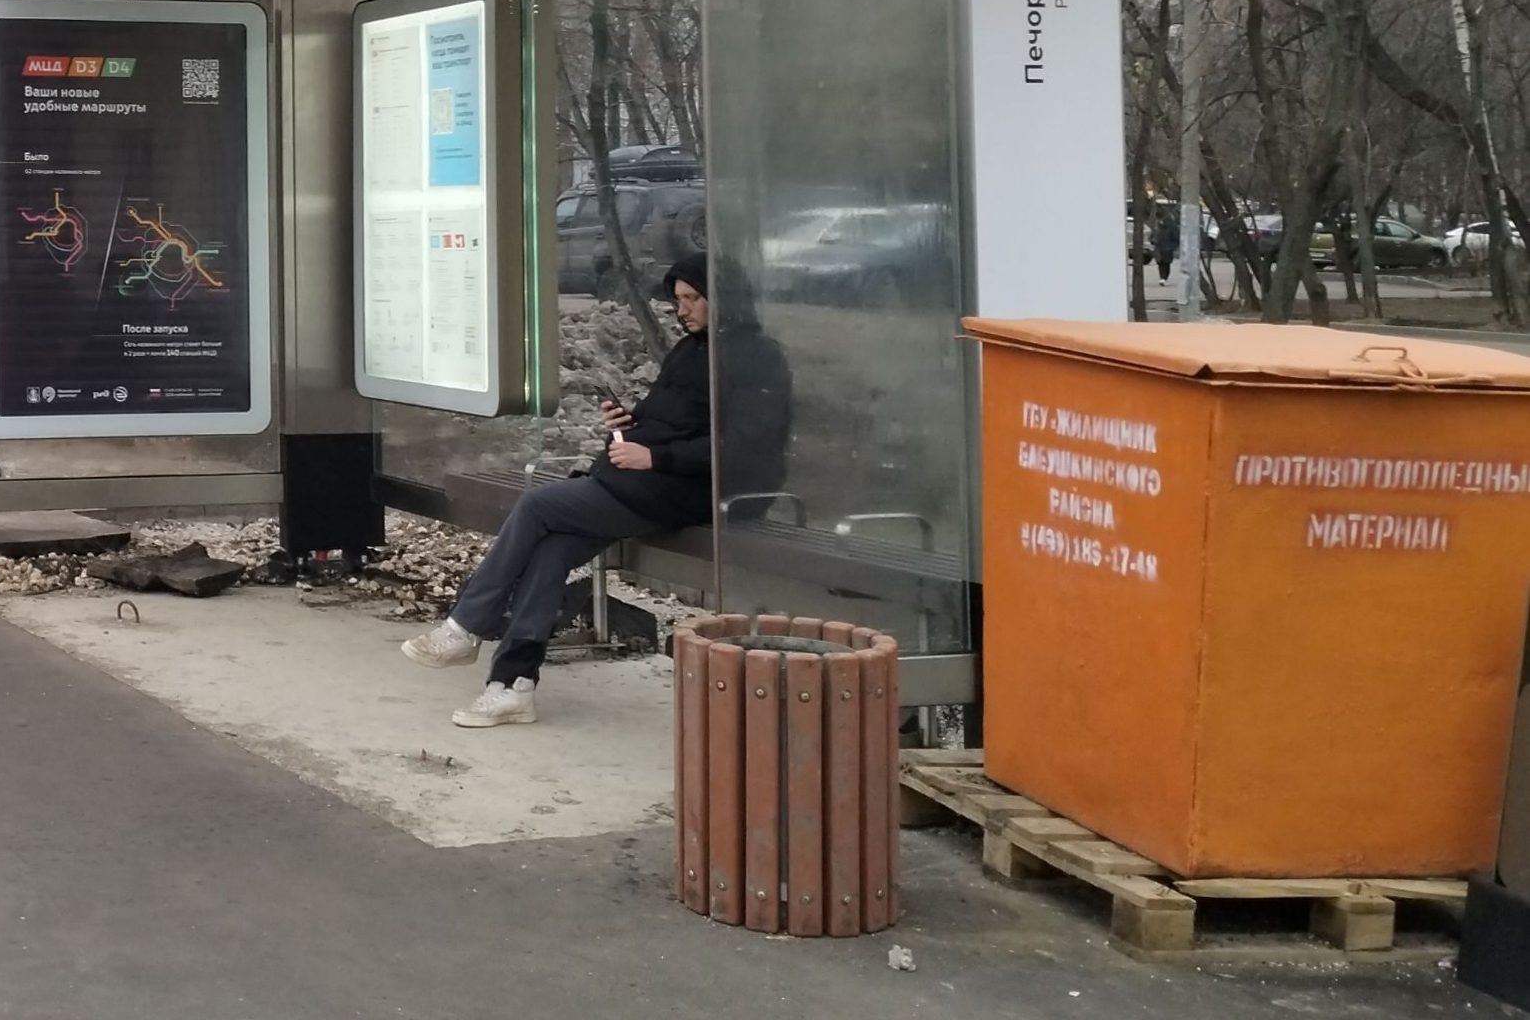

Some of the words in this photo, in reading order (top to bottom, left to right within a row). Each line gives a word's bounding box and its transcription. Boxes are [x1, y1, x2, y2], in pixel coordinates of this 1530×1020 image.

[28, 60, 63, 72] МЦД
[75, 62, 97, 74] D3
[108, 61, 130, 74] D4
[24, 85, 58, 98] Ваши
[60, 88, 101, 99] новые
[23, 100, 79, 114] удобные
[81, 102, 147, 115] маршруты
[24, 151, 50, 162] Было
[122, 323, 152, 334] После
[152, 325, 189, 335] запуска
[1022, 401, 1049, 430] ГБУ
[1018, 440, 1162, 497] БАБУШКИНСКОГО
[1234, 454, 1530, 494] ПРОТИВОГОЛОЛЕДНЫ
[1049, 486, 1115, 529] РАЙОНА
[1306, 512, 1449, 552] МАТЕРИАЛ
